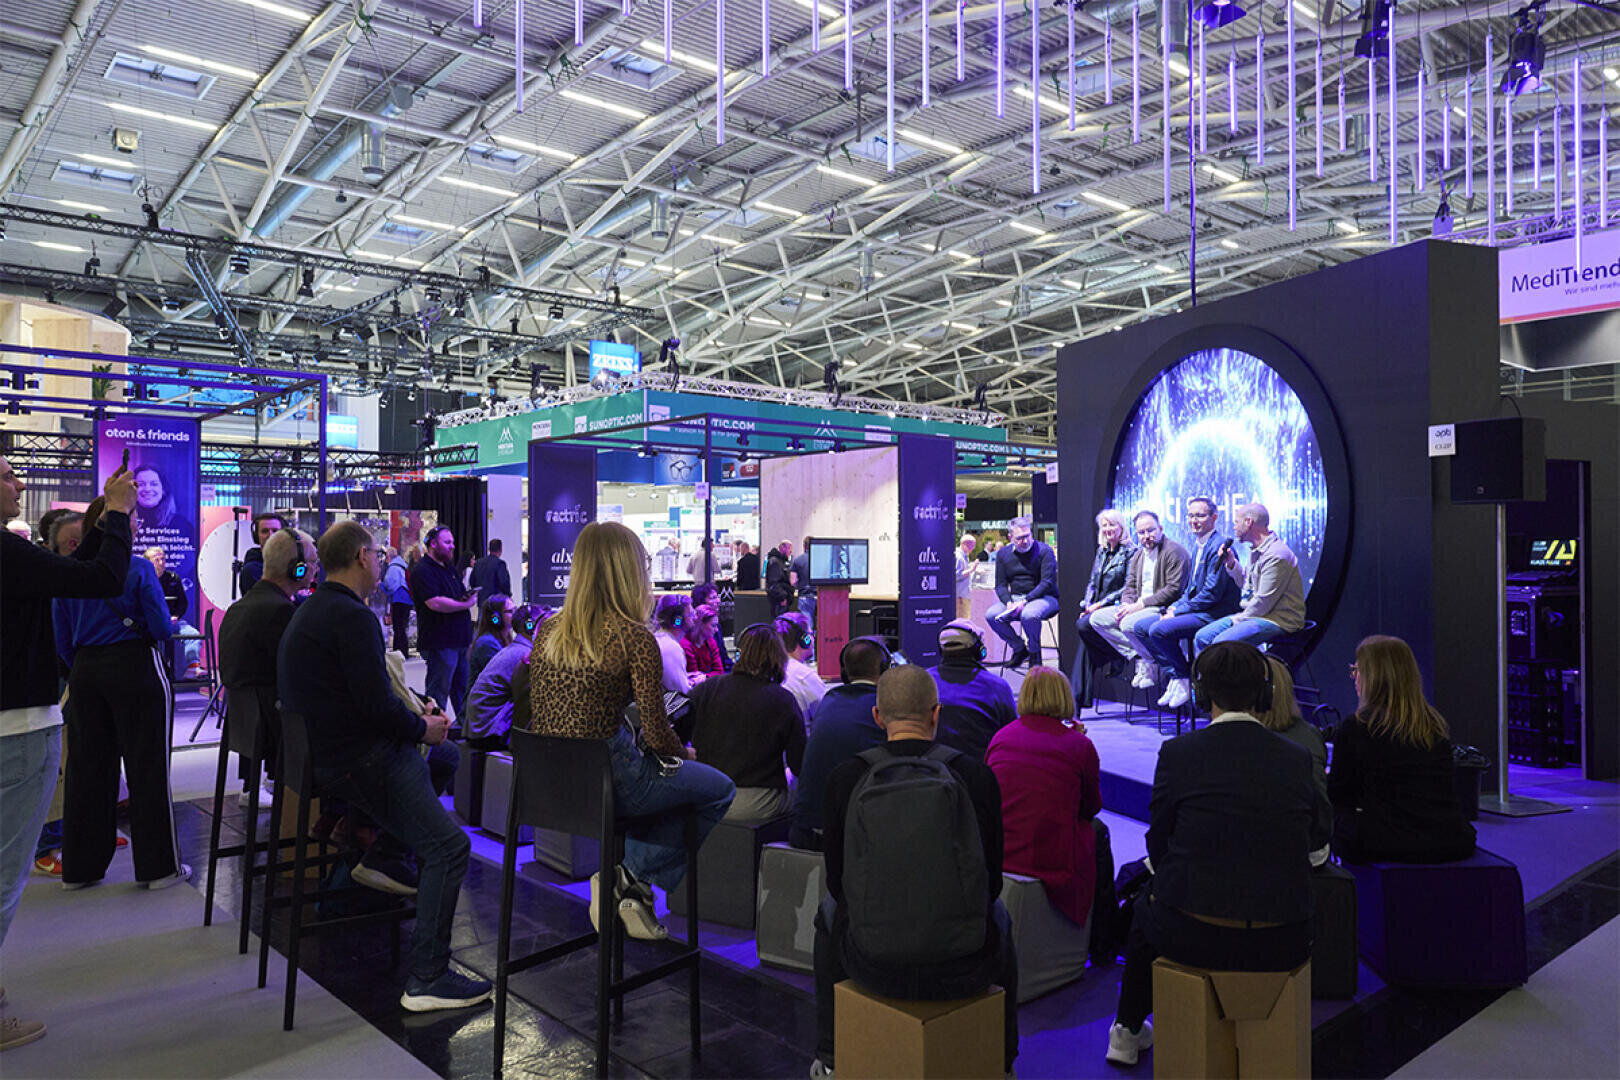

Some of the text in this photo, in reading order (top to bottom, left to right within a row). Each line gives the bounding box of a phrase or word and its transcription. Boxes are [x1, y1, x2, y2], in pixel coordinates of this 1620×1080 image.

[105, 427, 190, 442] oton & friends
